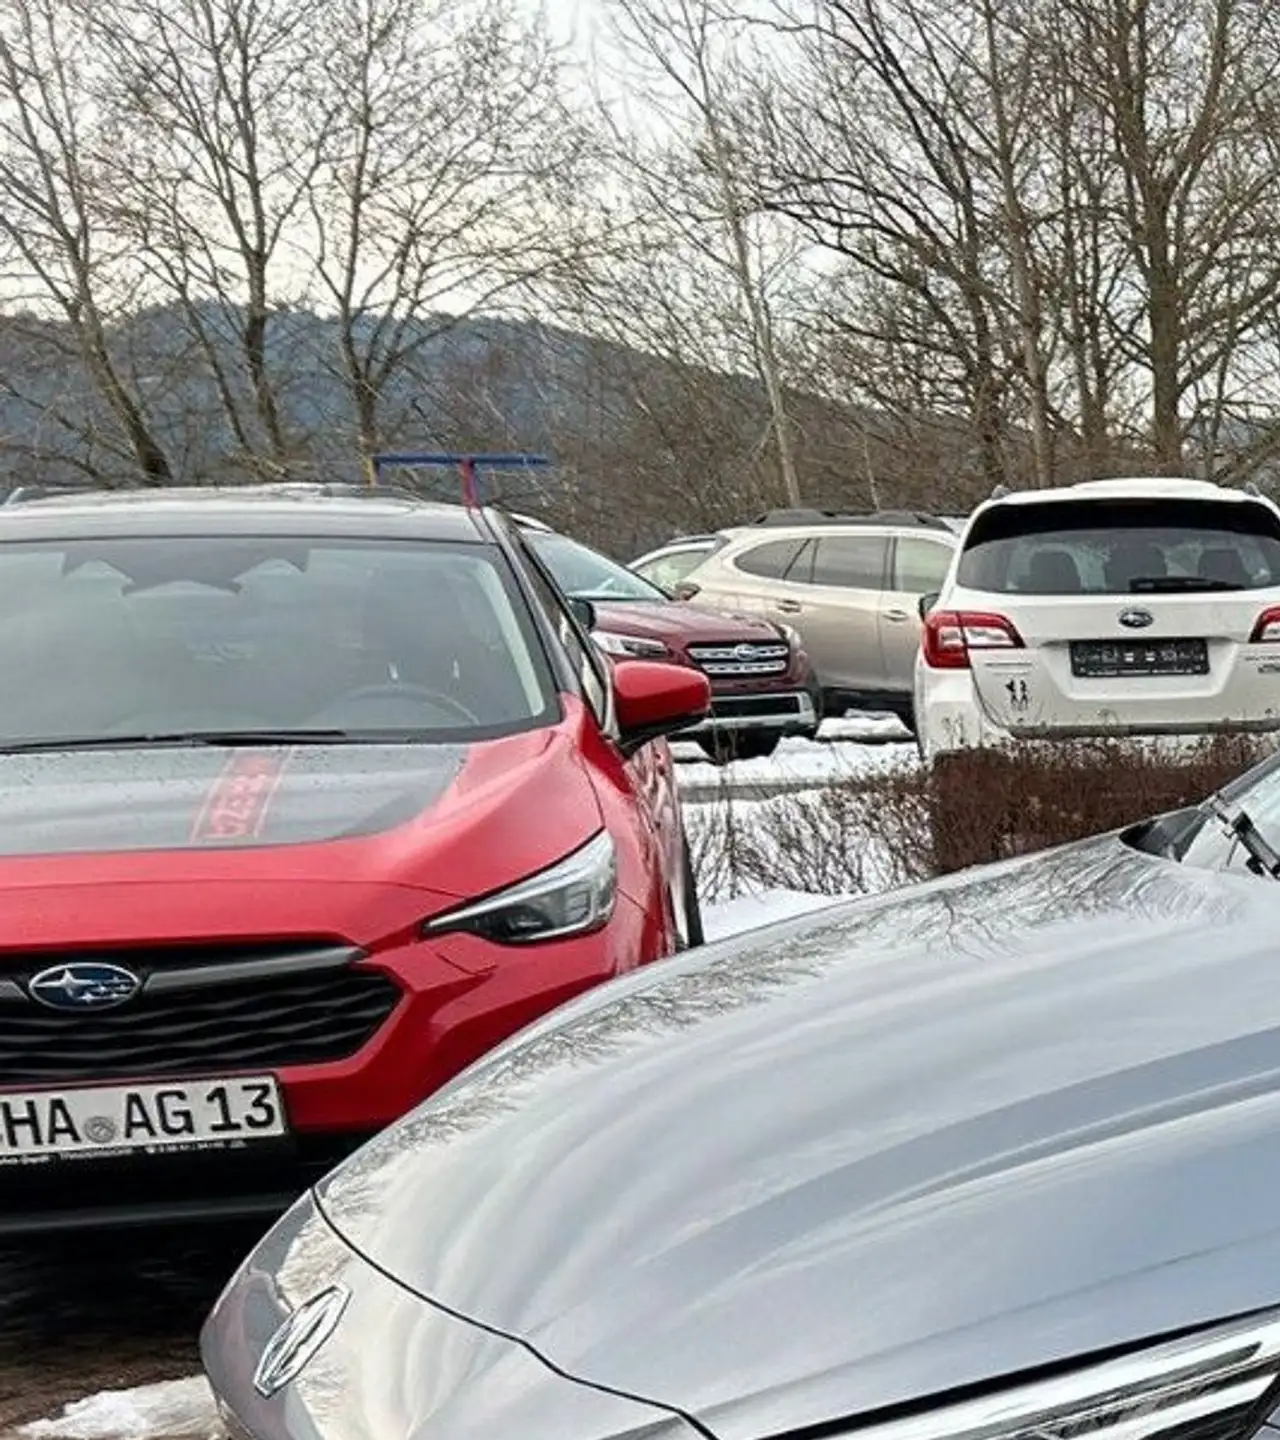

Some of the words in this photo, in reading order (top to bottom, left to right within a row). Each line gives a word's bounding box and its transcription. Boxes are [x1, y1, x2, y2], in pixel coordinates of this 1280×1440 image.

[0, 1097, 82, 1148] HA
[124, 1089, 195, 1139] AG
[205, 1083, 276, 1133] 13
